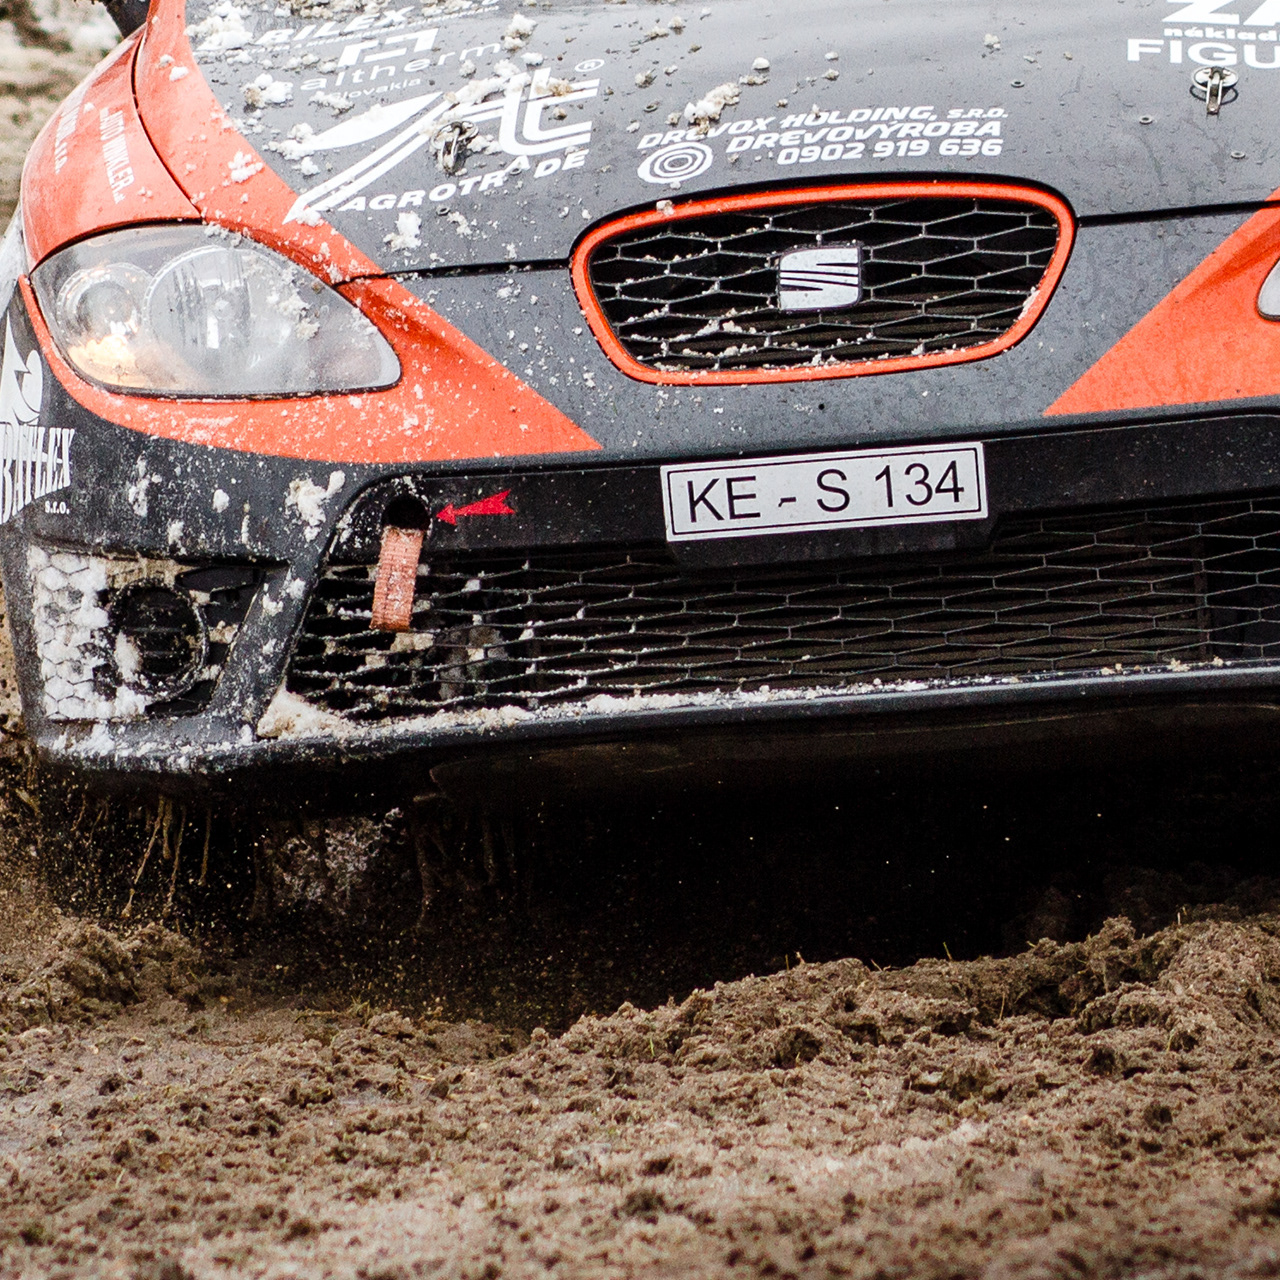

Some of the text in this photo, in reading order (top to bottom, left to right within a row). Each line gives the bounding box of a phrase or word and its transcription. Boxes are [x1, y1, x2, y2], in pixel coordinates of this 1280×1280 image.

[725, 119, 1003, 154] DREVOVÝROBA
[775, 138, 1005, 166] 0902 919 636
[337, 148, 590, 212] AGROTRADE
[44, 499, 71, 515] s.r.o.
[685, 474, 762, 524] KE
[815, 468, 851, 514] S
[874, 459, 965, 509] 134
